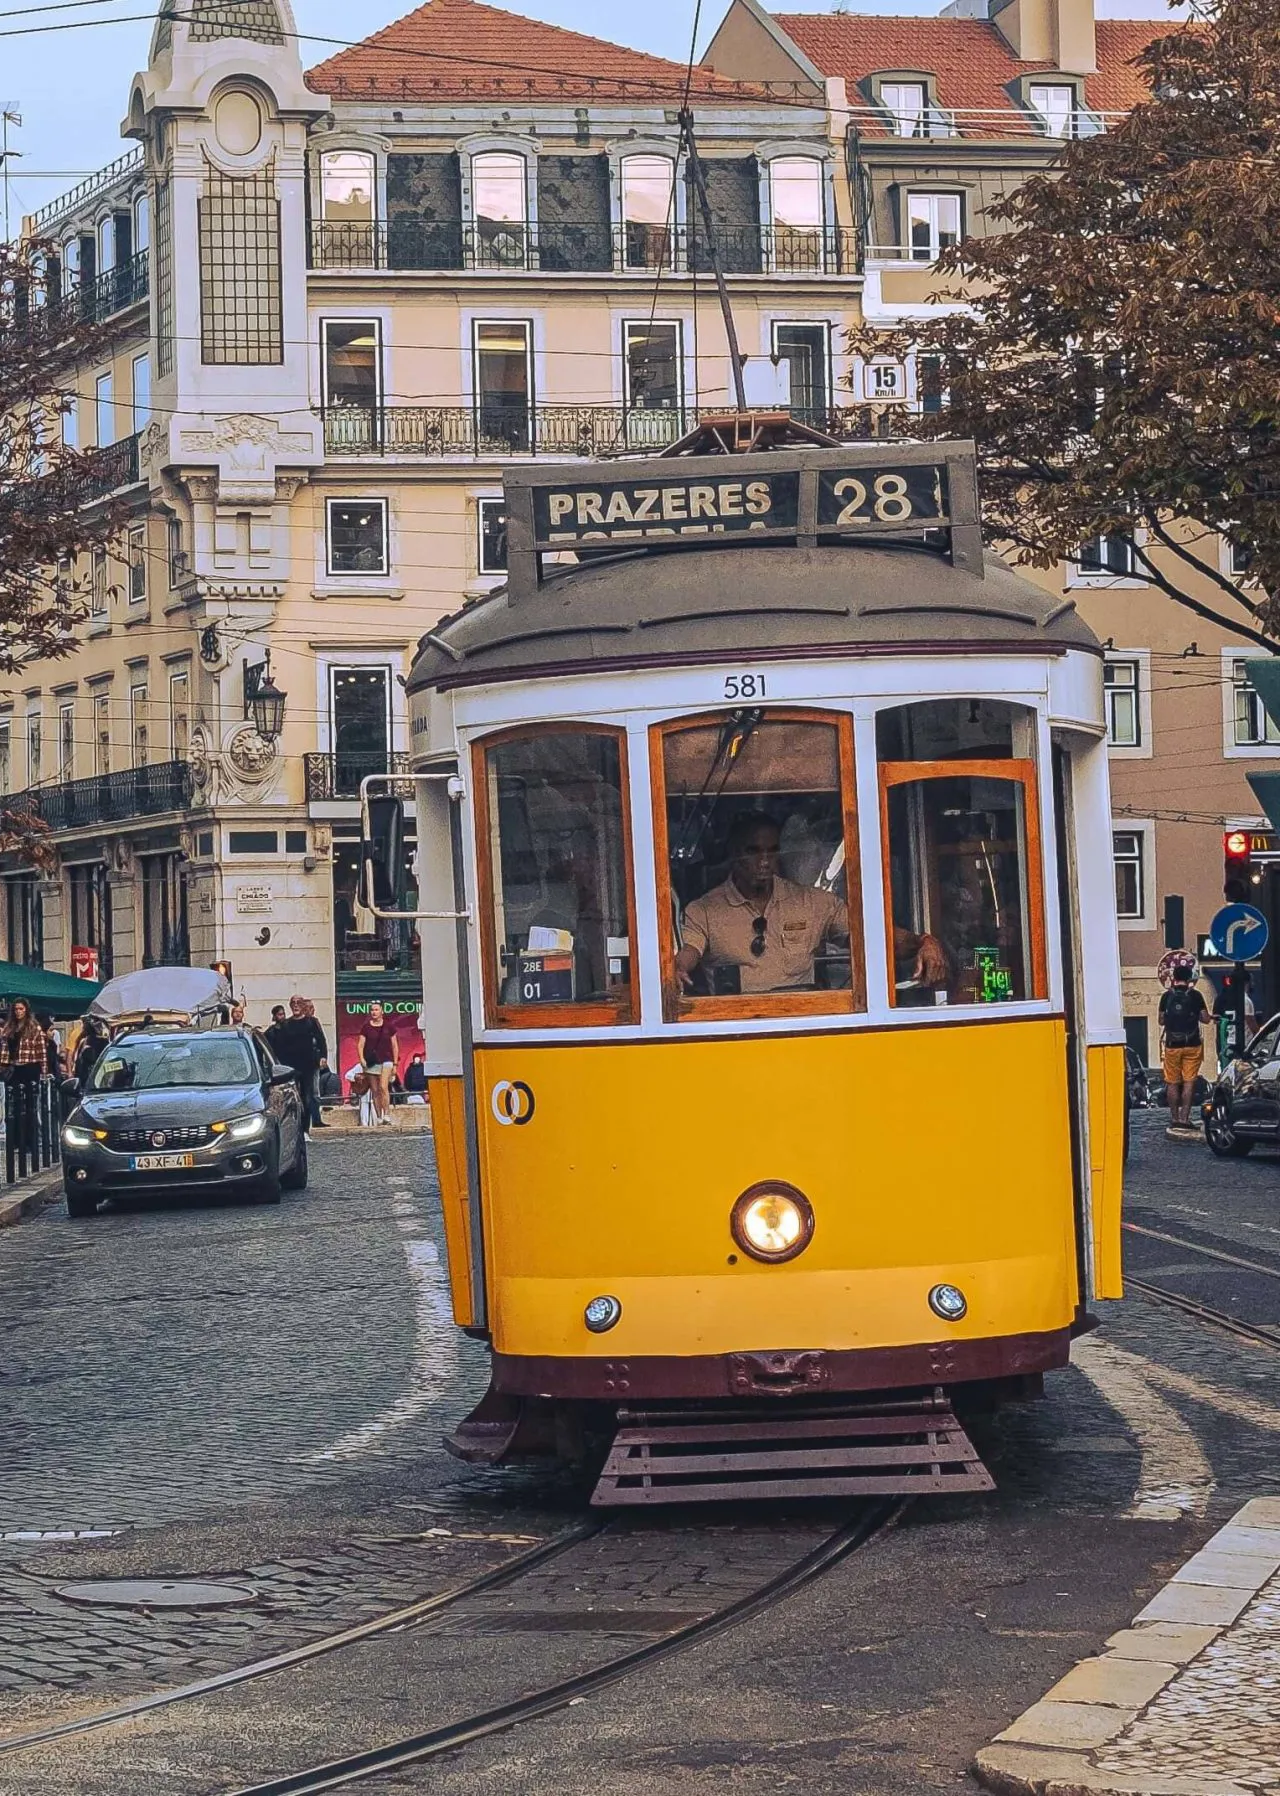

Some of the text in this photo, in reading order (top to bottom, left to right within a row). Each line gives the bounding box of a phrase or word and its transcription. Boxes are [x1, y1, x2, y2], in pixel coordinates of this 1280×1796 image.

[872, 366, 896, 388] 15
[548, 481, 772, 526] PRAZERES
[833, 474, 913, 526] 28
[724, 674, 766, 699] 581
[523, 961, 542, 973] 28E
[524, 983, 541, 999] 01
[346, 1002, 393, 1014] UNID
